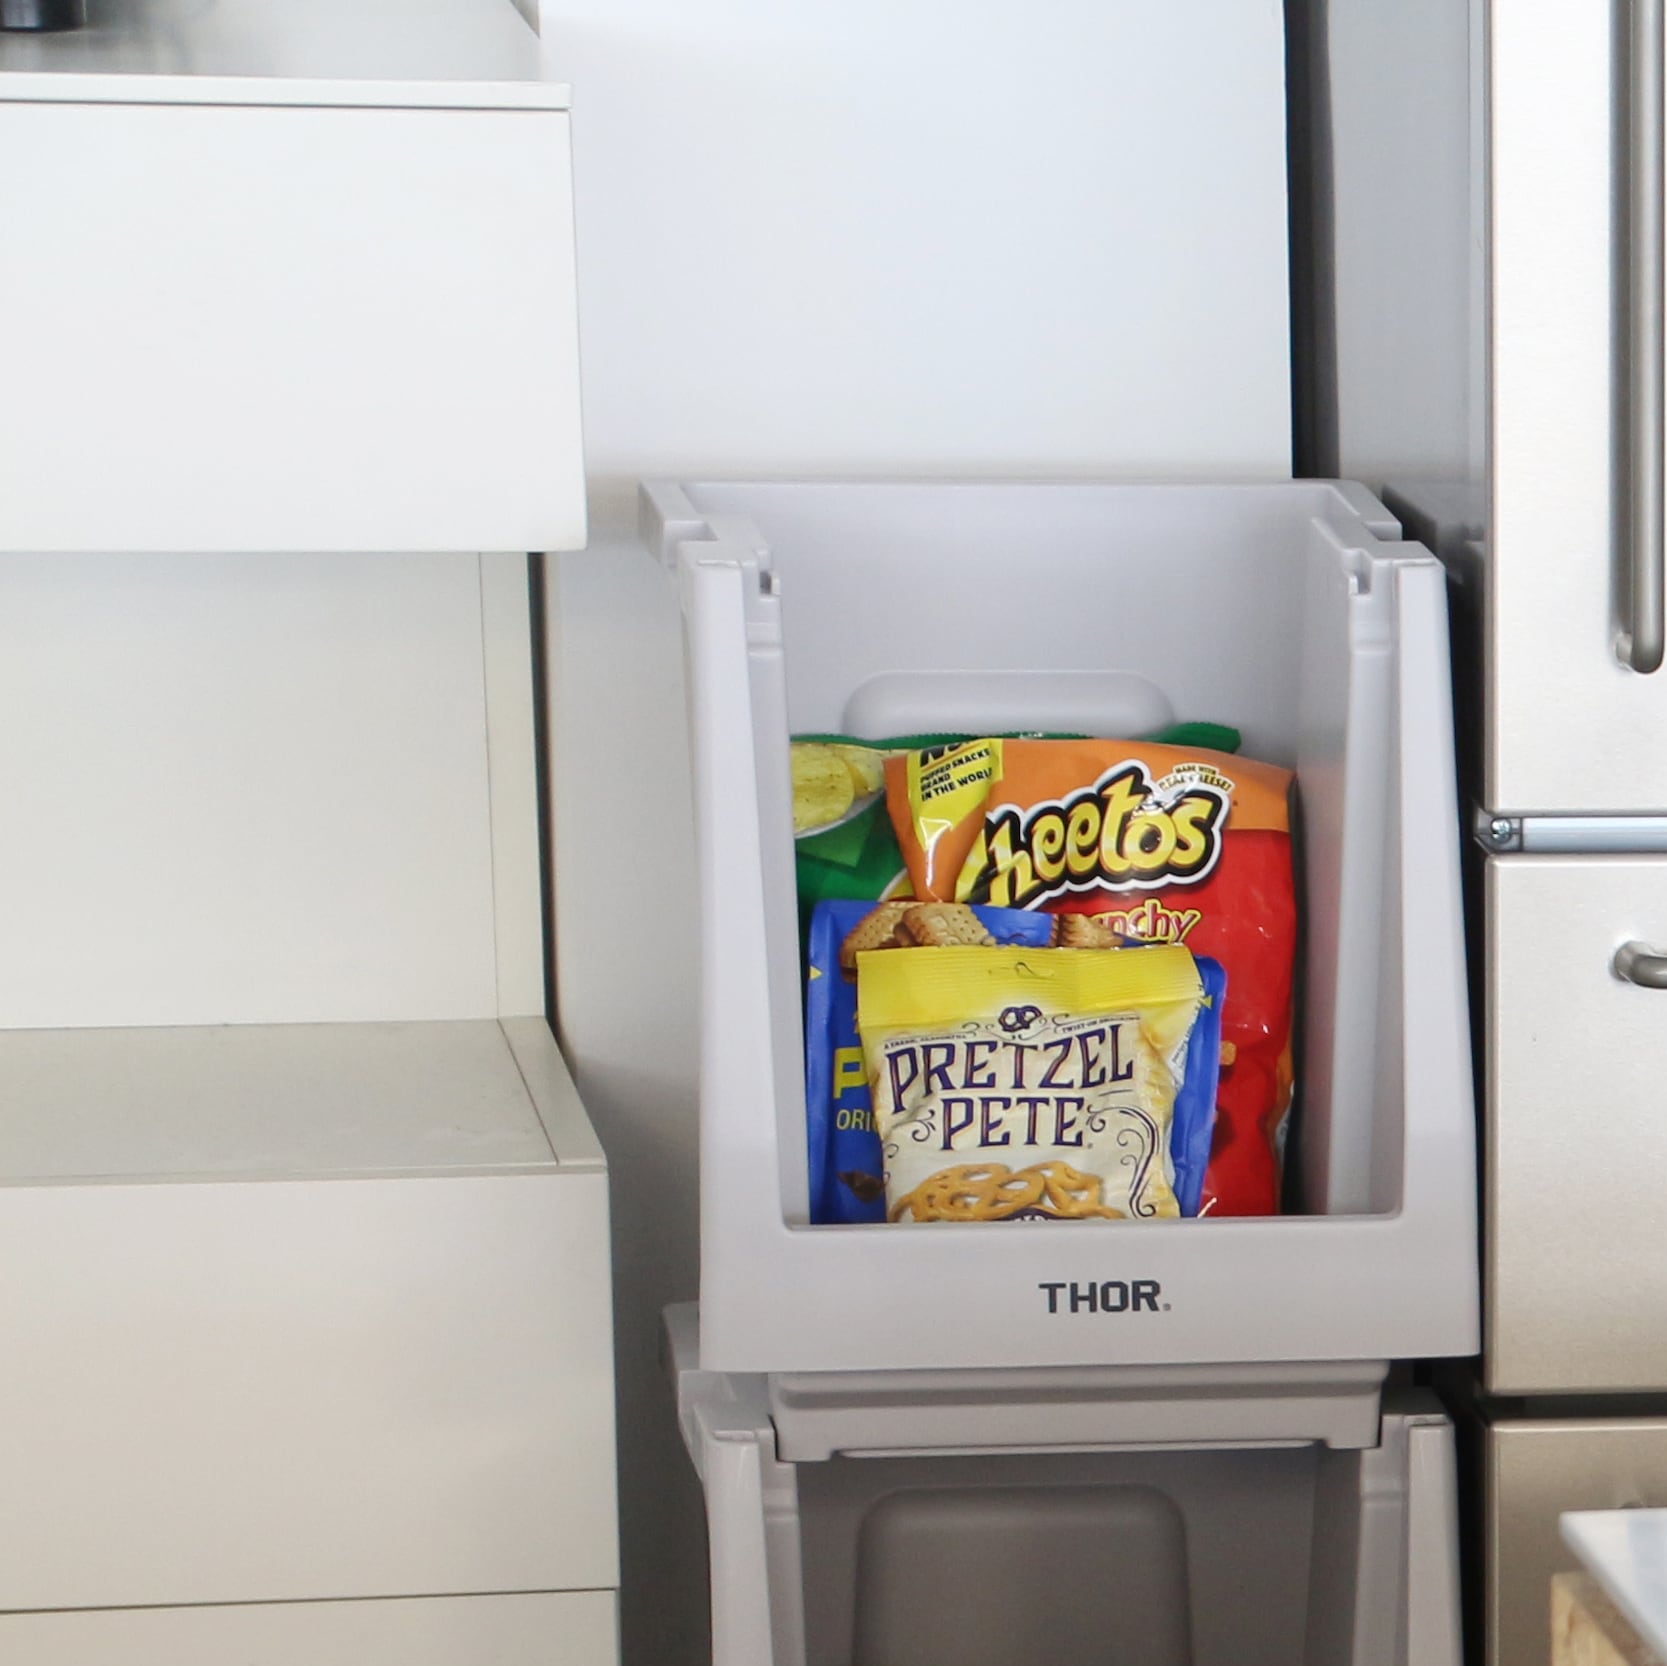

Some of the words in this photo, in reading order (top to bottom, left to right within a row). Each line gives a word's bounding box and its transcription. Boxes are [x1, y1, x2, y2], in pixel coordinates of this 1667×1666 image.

[933, 781, 957, 797] THE
[886, 1023, 1134, 1115] PRETZEL
[941, 1096, 1085, 1151] PETE
[1038, 1279, 1161, 1314] THOR
